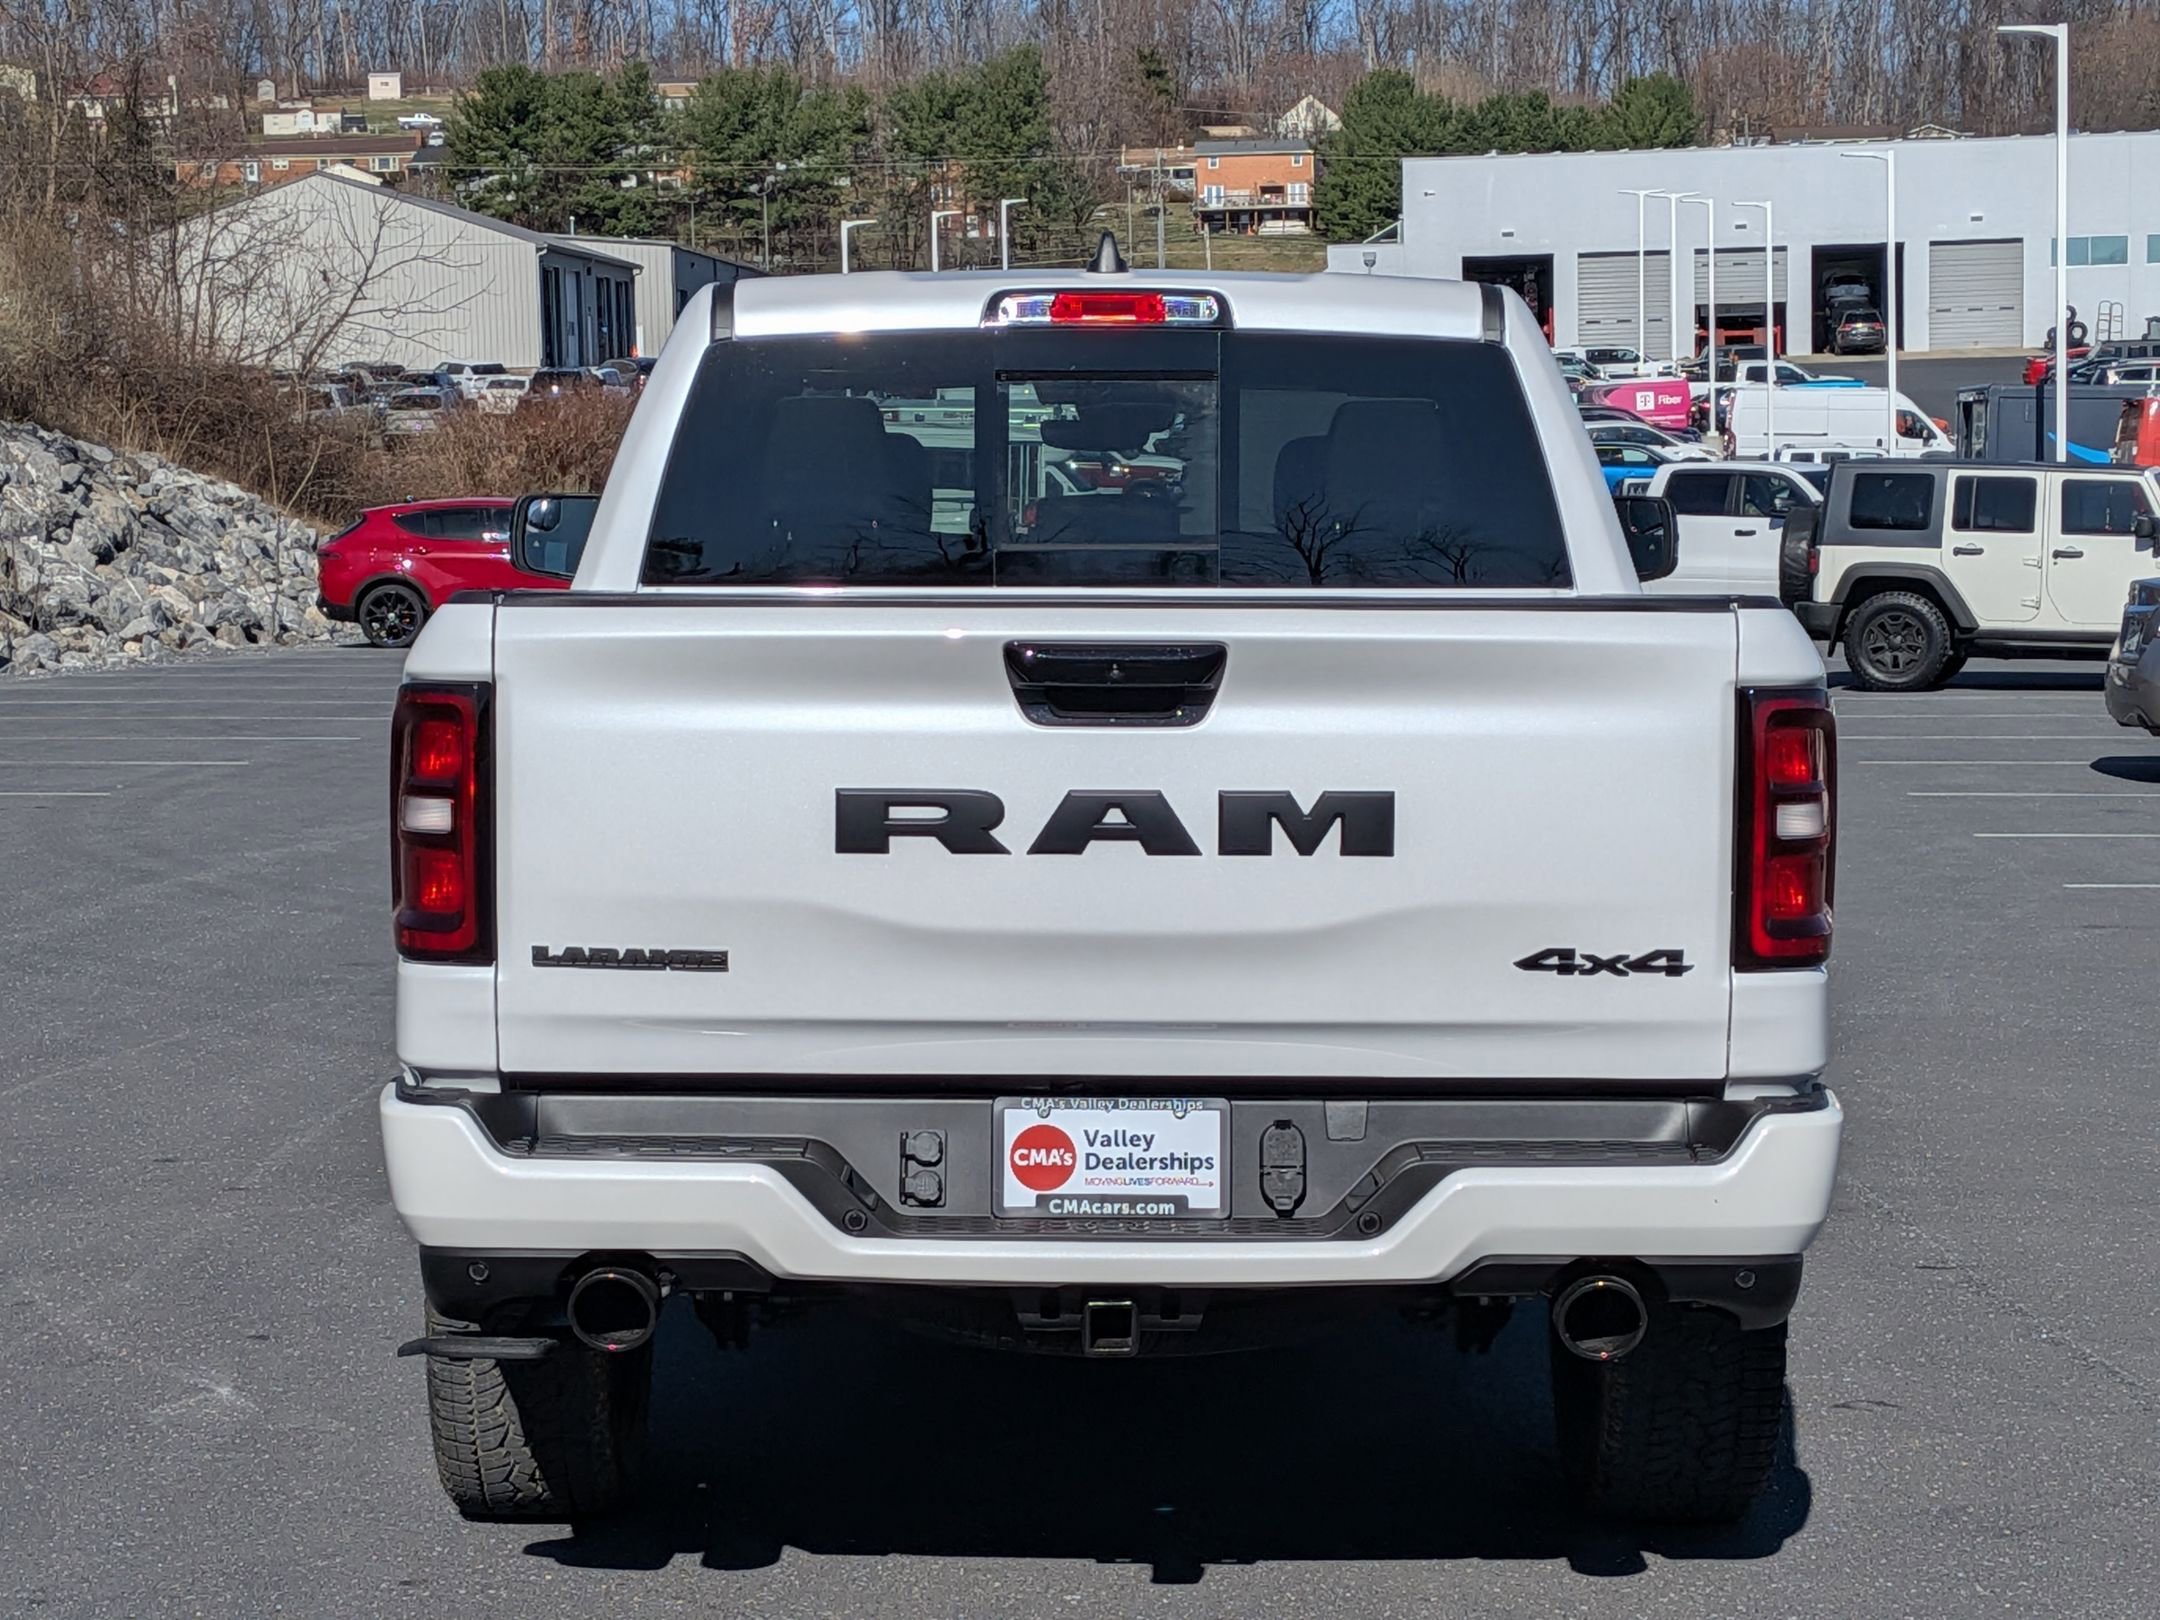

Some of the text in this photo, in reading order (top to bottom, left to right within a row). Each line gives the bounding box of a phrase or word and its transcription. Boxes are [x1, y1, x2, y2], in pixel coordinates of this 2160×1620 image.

[1658, 394, 1682, 405] Fiber
[834, 788, 1396, 856] RAM
[1513, 948, 1695, 976] 4x4
[1070, 1097, 1115, 1113] Valley
[1118, 1097, 1204, 1113] Dealerships
[1083, 1129, 1155, 1152] Valley
[1013, 1148, 1073, 1167] CMA's
[1084, 1152, 1214, 1175] Dealerships
[1048, 1199, 1175, 1216] CMAcars.com
